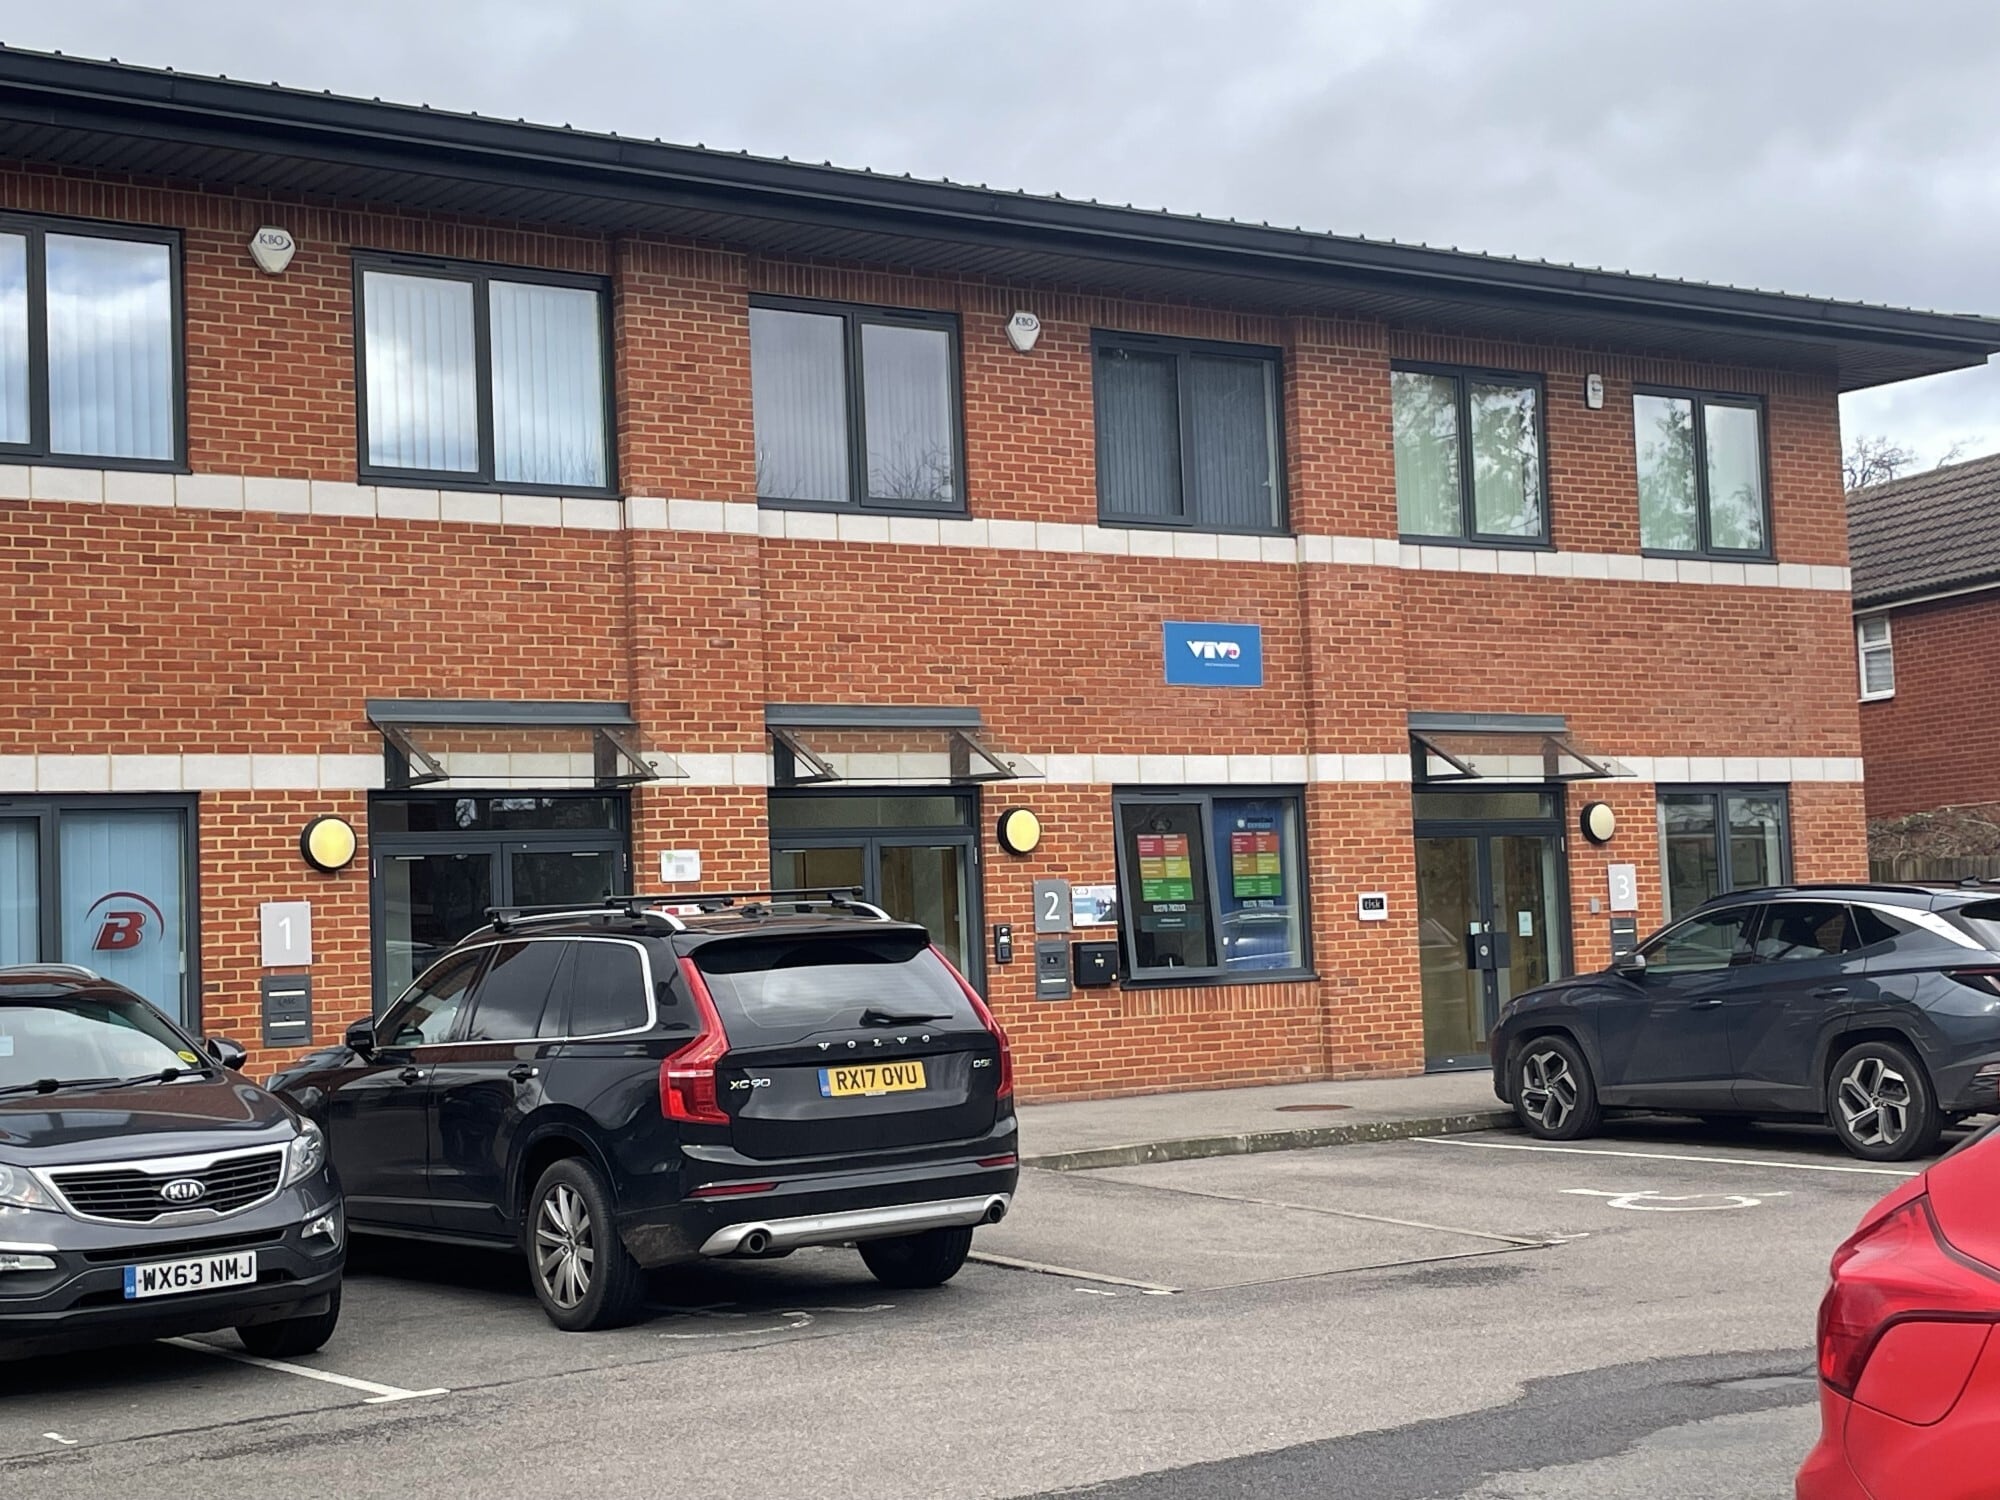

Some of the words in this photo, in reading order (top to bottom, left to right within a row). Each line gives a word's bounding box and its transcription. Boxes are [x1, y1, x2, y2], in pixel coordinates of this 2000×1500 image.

[259, 233, 284, 246] KBO
[1616, 874, 1630, 900] 3
[1044, 891, 1061, 921] 2
[92, 912, 147, 952] B
[278, 916, 292, 951] 1
[817, 1034, 930, 1051] VOLVO
[835, 1068, 876, 1091] RX17
[881, 1064, 918, 1087] OVU
[170, 1183, 200, 1199] KIA
[143, 1263, 204, 1292] WX63
[210, 1255, 253, 1283] NMJ
